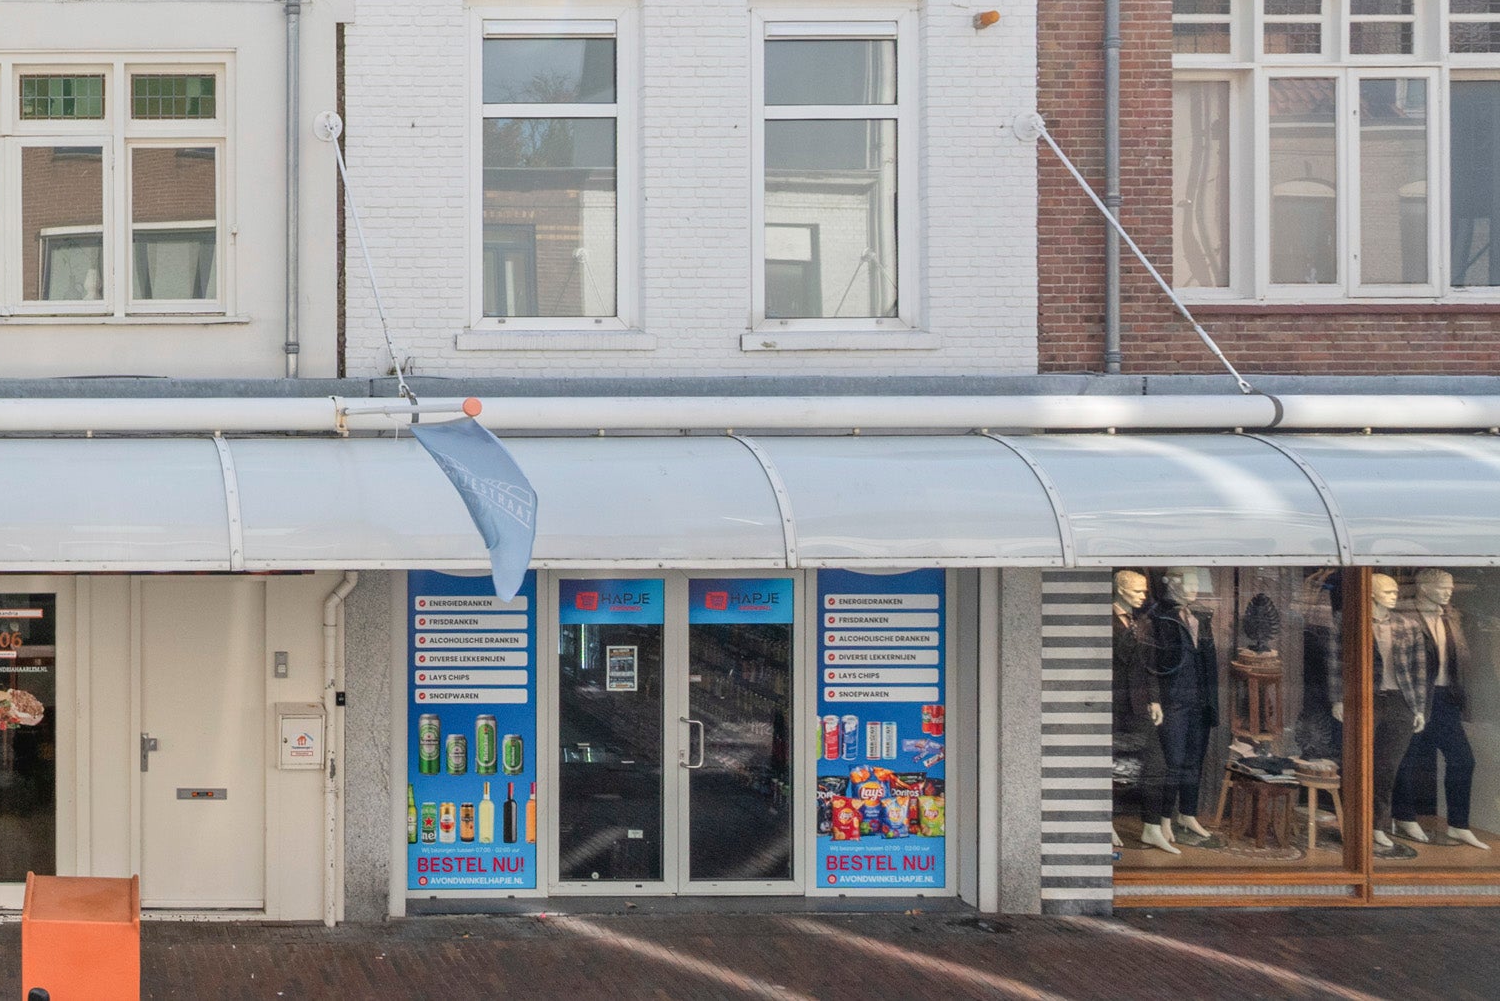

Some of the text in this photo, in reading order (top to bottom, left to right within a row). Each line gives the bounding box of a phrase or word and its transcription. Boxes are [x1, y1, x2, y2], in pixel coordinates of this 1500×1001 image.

[601, 593, 651, 604] HAPJE
[731, 592, 780, 604] HAPJE
[417, 857, 525, 873] BESTEL NU!
[826, 855, 935, 871] BESTEL NU!
[430, 877, 524, 885] AVONDWINKELHAPJE.NL
[840, 875, 935, 883] AVONDWINKELHAPJE.NL
